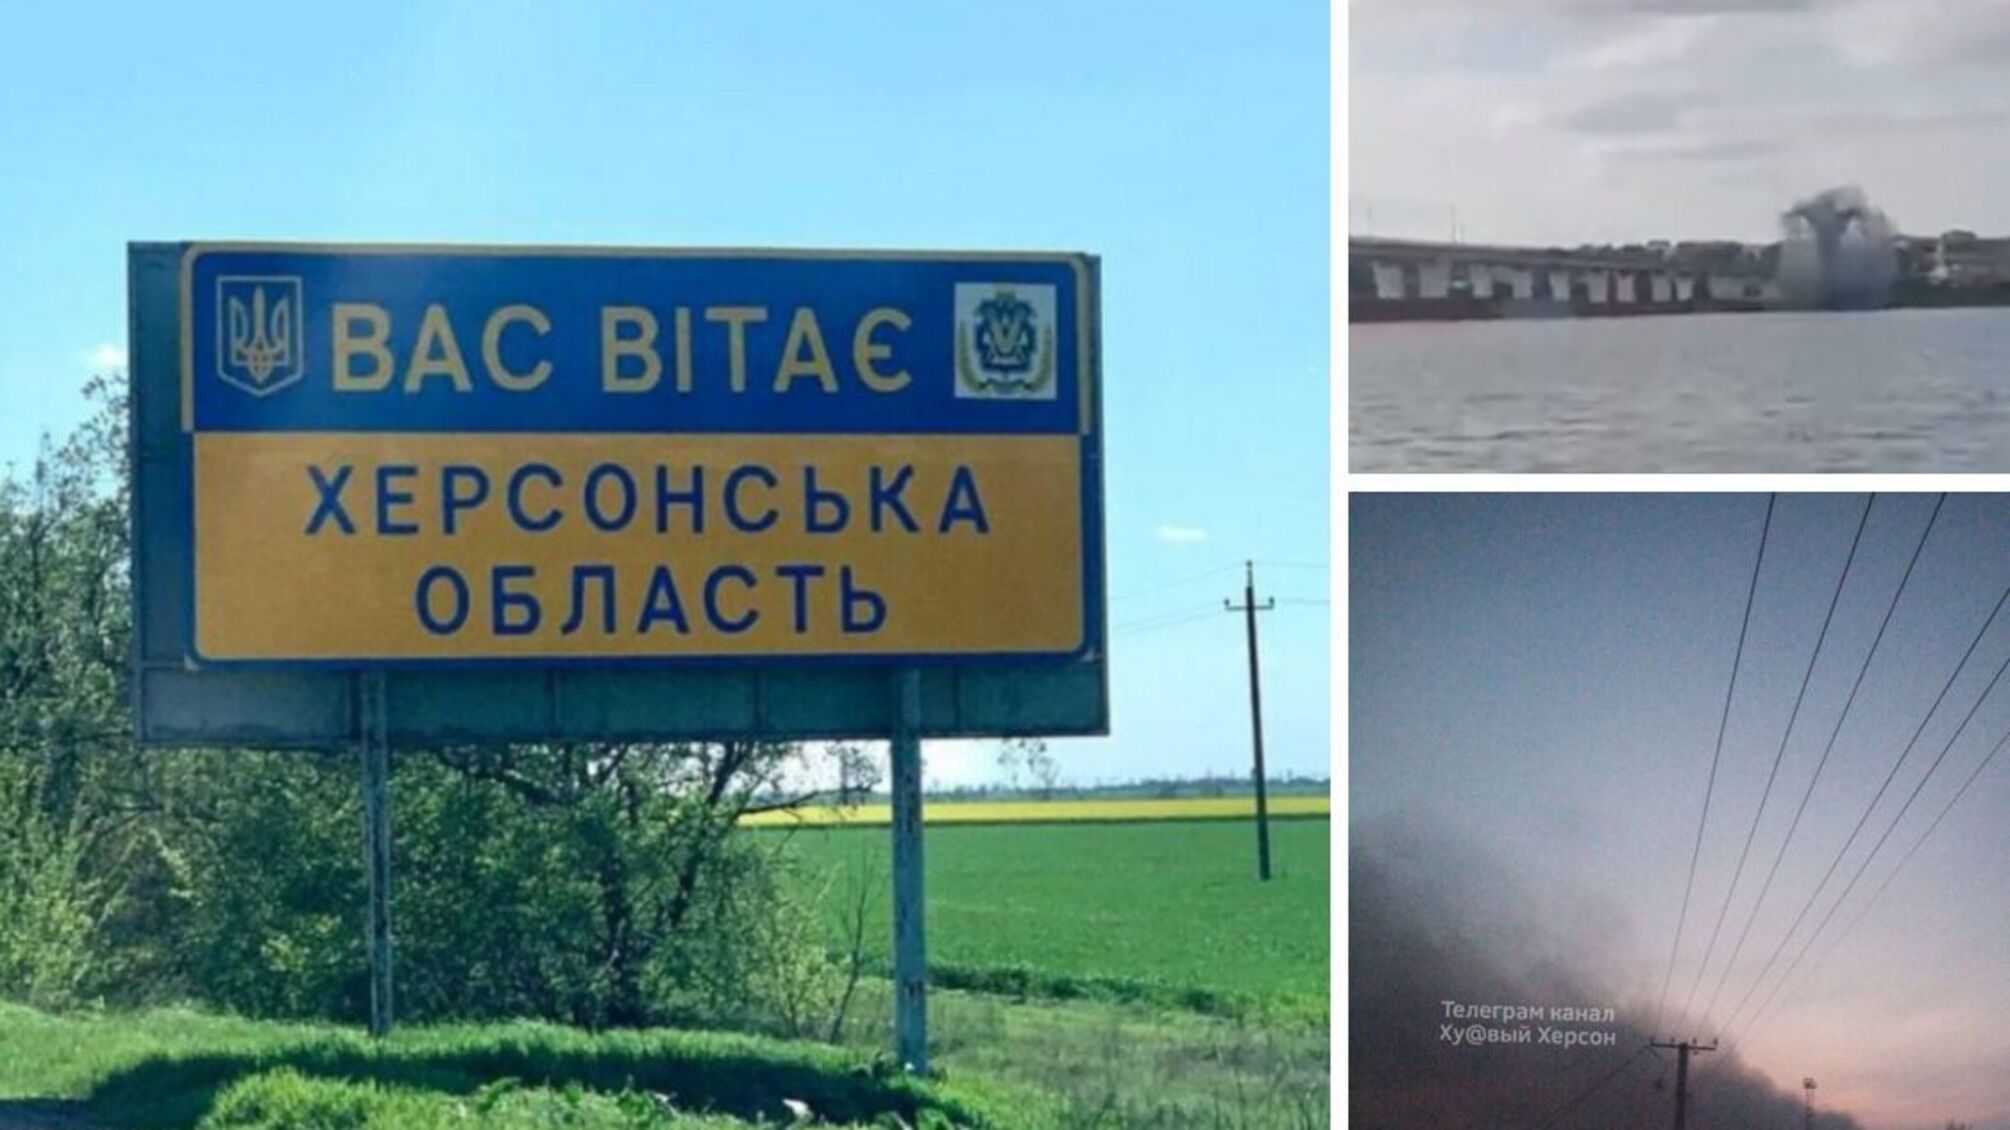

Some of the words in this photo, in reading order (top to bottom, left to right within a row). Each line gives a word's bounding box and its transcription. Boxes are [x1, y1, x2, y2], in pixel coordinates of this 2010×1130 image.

[331, 302, 553, 394] ВАС
[601, 304, 913, 395] ВІТАЄ
[304, 462, 990, 536] ХЕРСОНСЬКА
[414, 564, 888, 636] ОБЛАСТЬ
